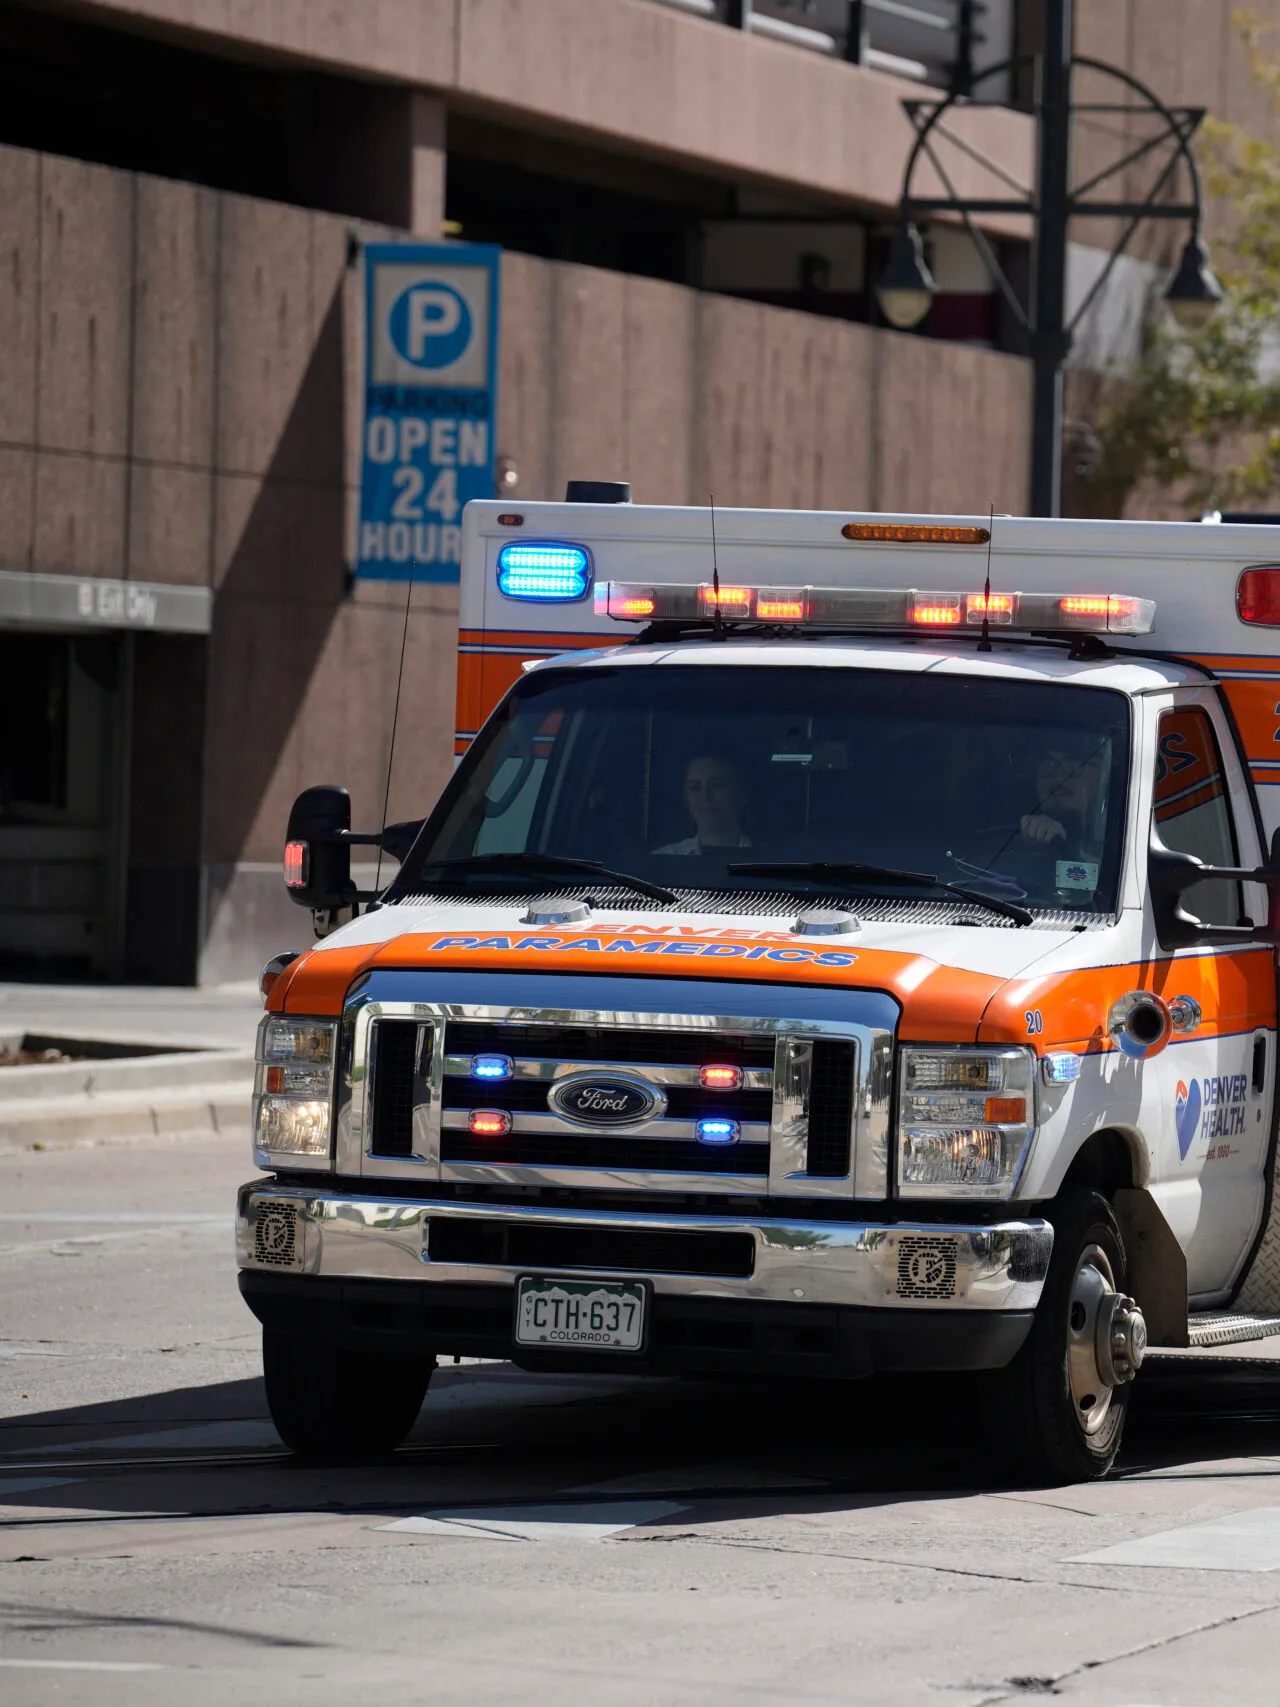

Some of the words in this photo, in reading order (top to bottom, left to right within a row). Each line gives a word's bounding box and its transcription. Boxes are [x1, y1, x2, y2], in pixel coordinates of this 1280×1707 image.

[367, 416, 488, 467] OPEN
[391, 467, 459, 521] 24
[538, 922, 801, 942] DENVER
[427, 935, 860, 967] PARAMEDICS
[1025, 1010, 1043, 1035] 20
[577, 1087, 628, 1111] Ford
[1203, 1075, 1247, 1105] DENVER
[550, 1330, 611, 1343] COLORADO
